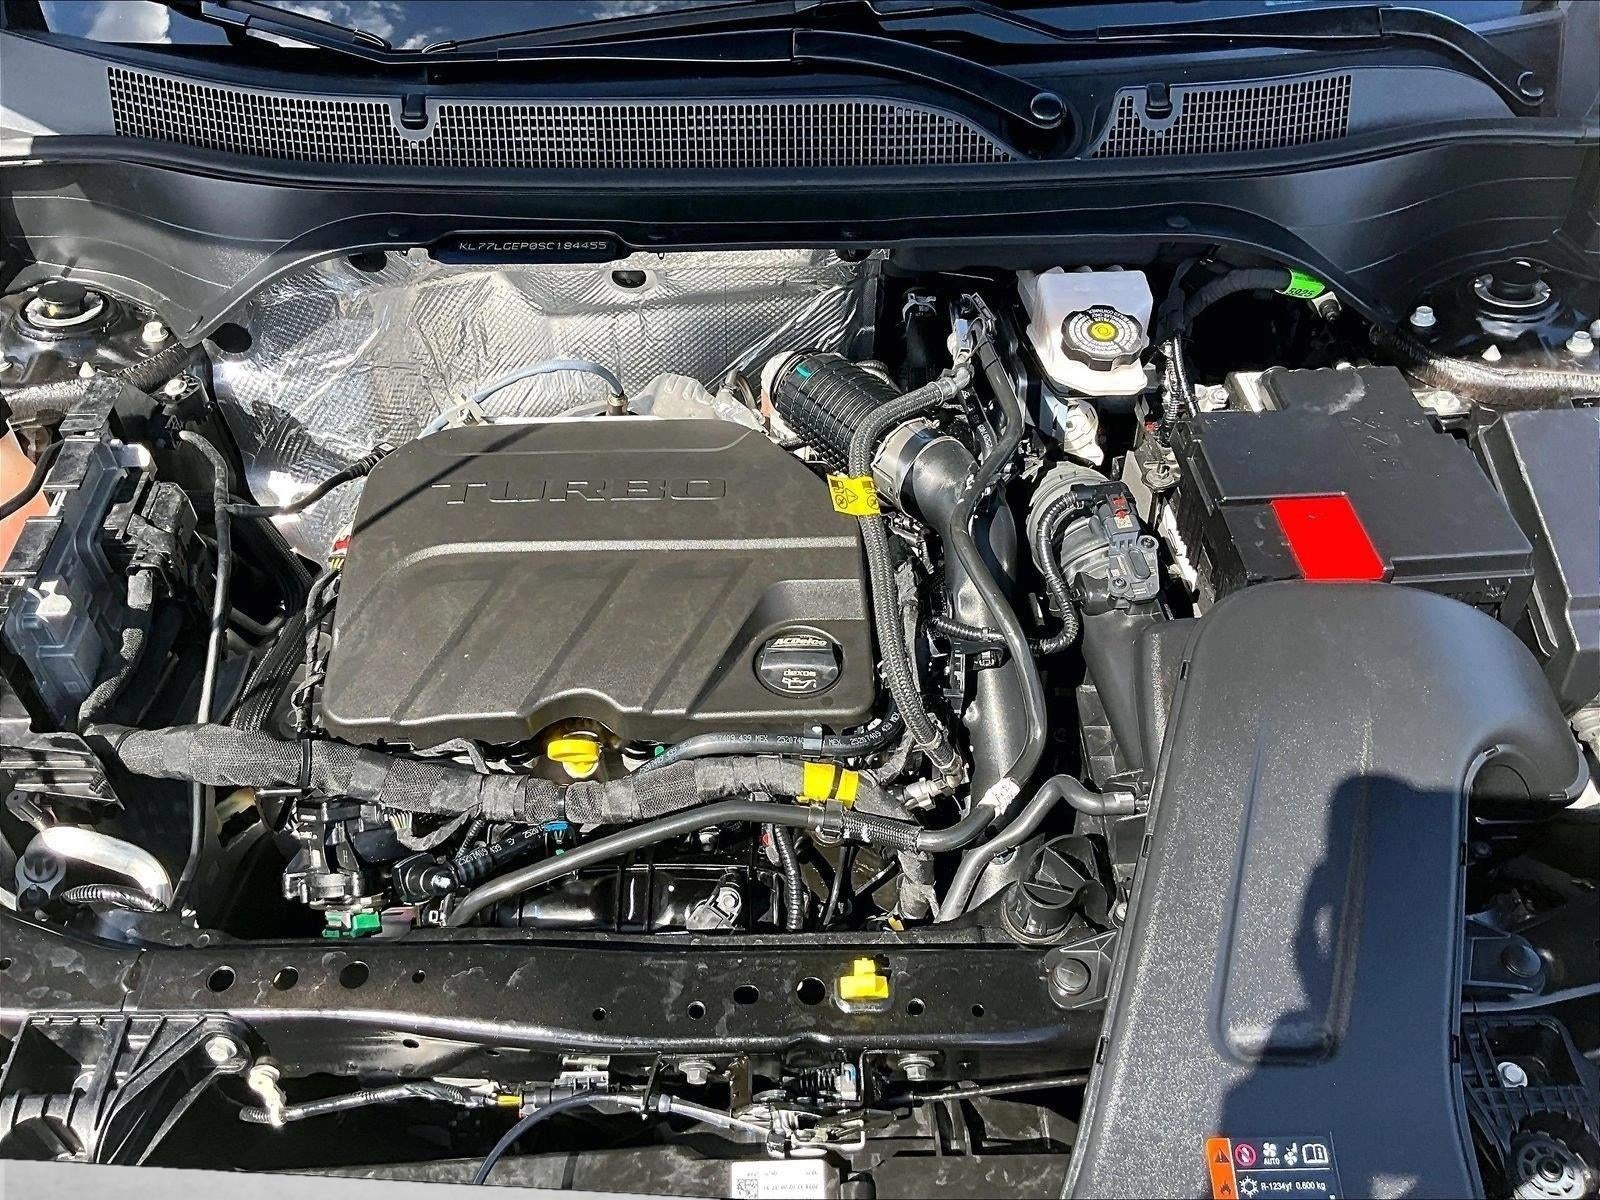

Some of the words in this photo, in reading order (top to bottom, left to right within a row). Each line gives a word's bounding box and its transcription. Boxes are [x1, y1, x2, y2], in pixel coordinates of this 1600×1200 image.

[431, 480, 726, 505] TURBO
[755, 734, 769, 744] MEX
[1263, 1157, 1281, 1166] AUTO
[1316, 1180, 1327, 1192] kg
